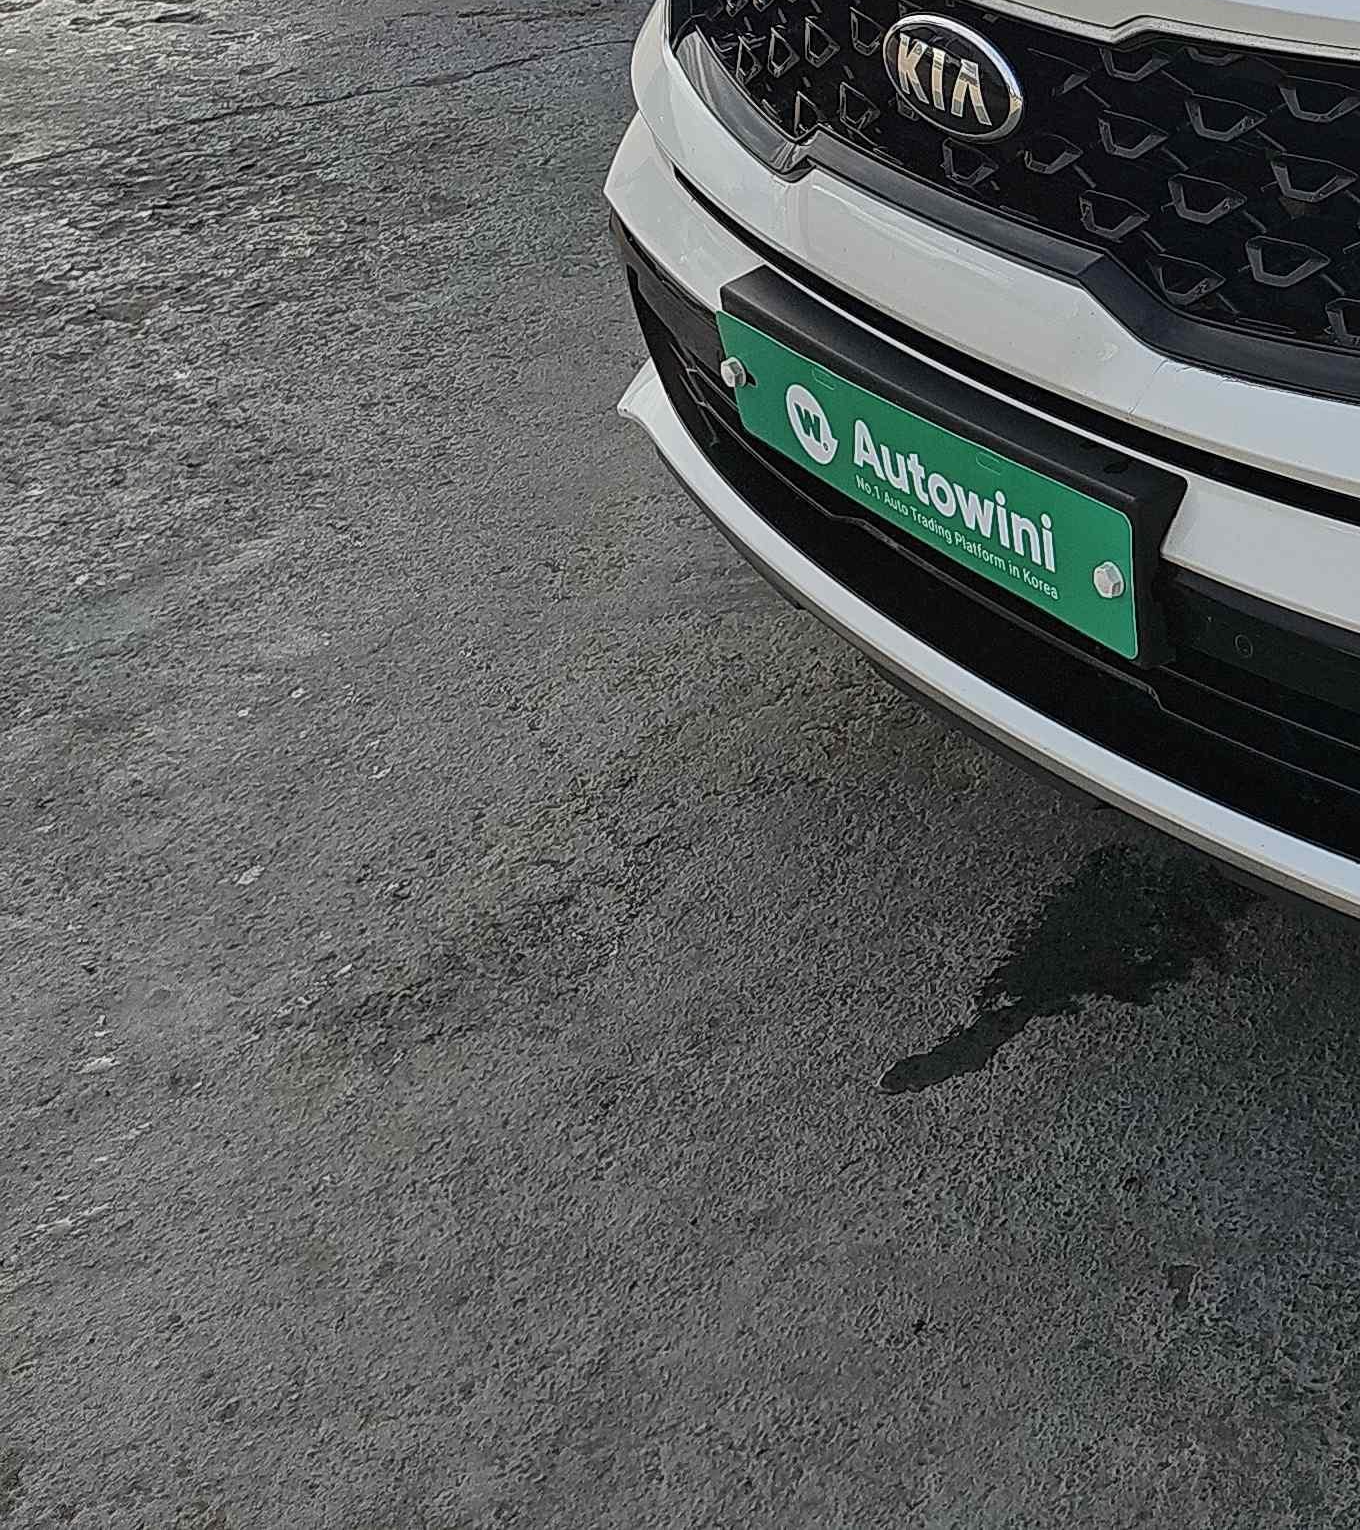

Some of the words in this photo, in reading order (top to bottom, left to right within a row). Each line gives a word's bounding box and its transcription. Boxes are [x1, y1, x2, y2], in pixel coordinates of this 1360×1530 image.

[897, 32, 993, 127] KIA
[853, 419, 1056, 573] Autowini
[856, 474, 881, 500] No.1
[883, 491, 909, 516] Auto
[910, 506, 953, 545] Trading
[954, 531, 1006, 571] Platform
[1008, 560, 1021, 578] in
[1022, 570, 1059, 600] Korea
